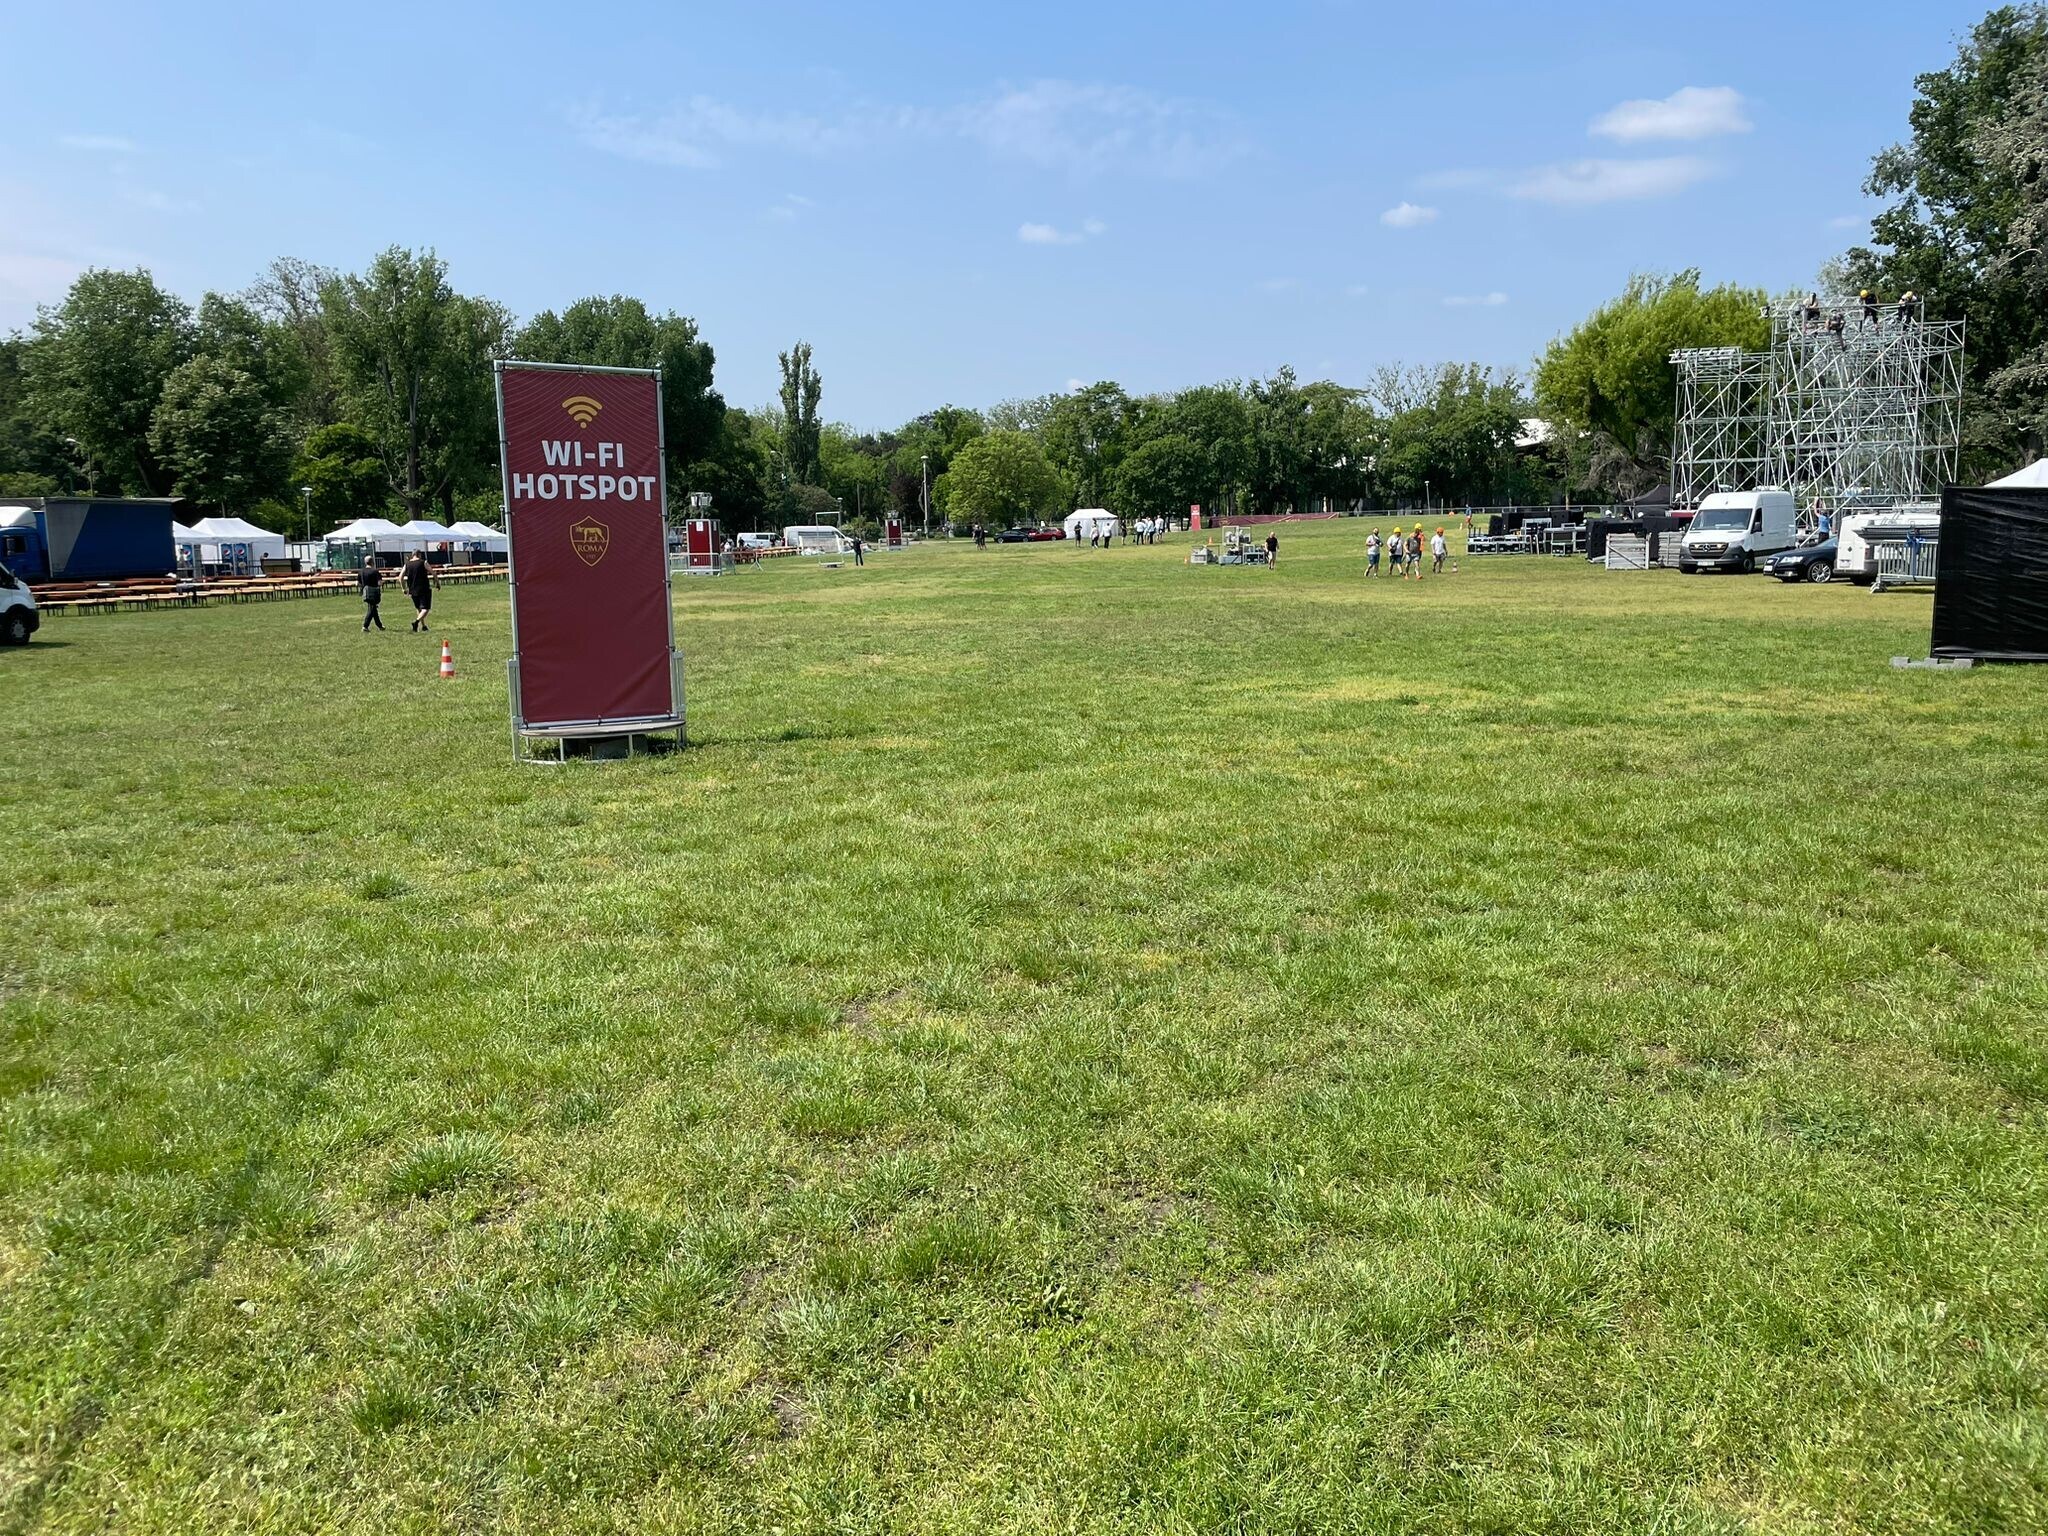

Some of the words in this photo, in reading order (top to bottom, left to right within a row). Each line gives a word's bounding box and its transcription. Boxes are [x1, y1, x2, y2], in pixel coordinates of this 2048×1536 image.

[541, 440, 624, 468] WI-FI
[513, 473, 656, 501] HOTSPOT
[577, 544, 604, 552] ROMA
